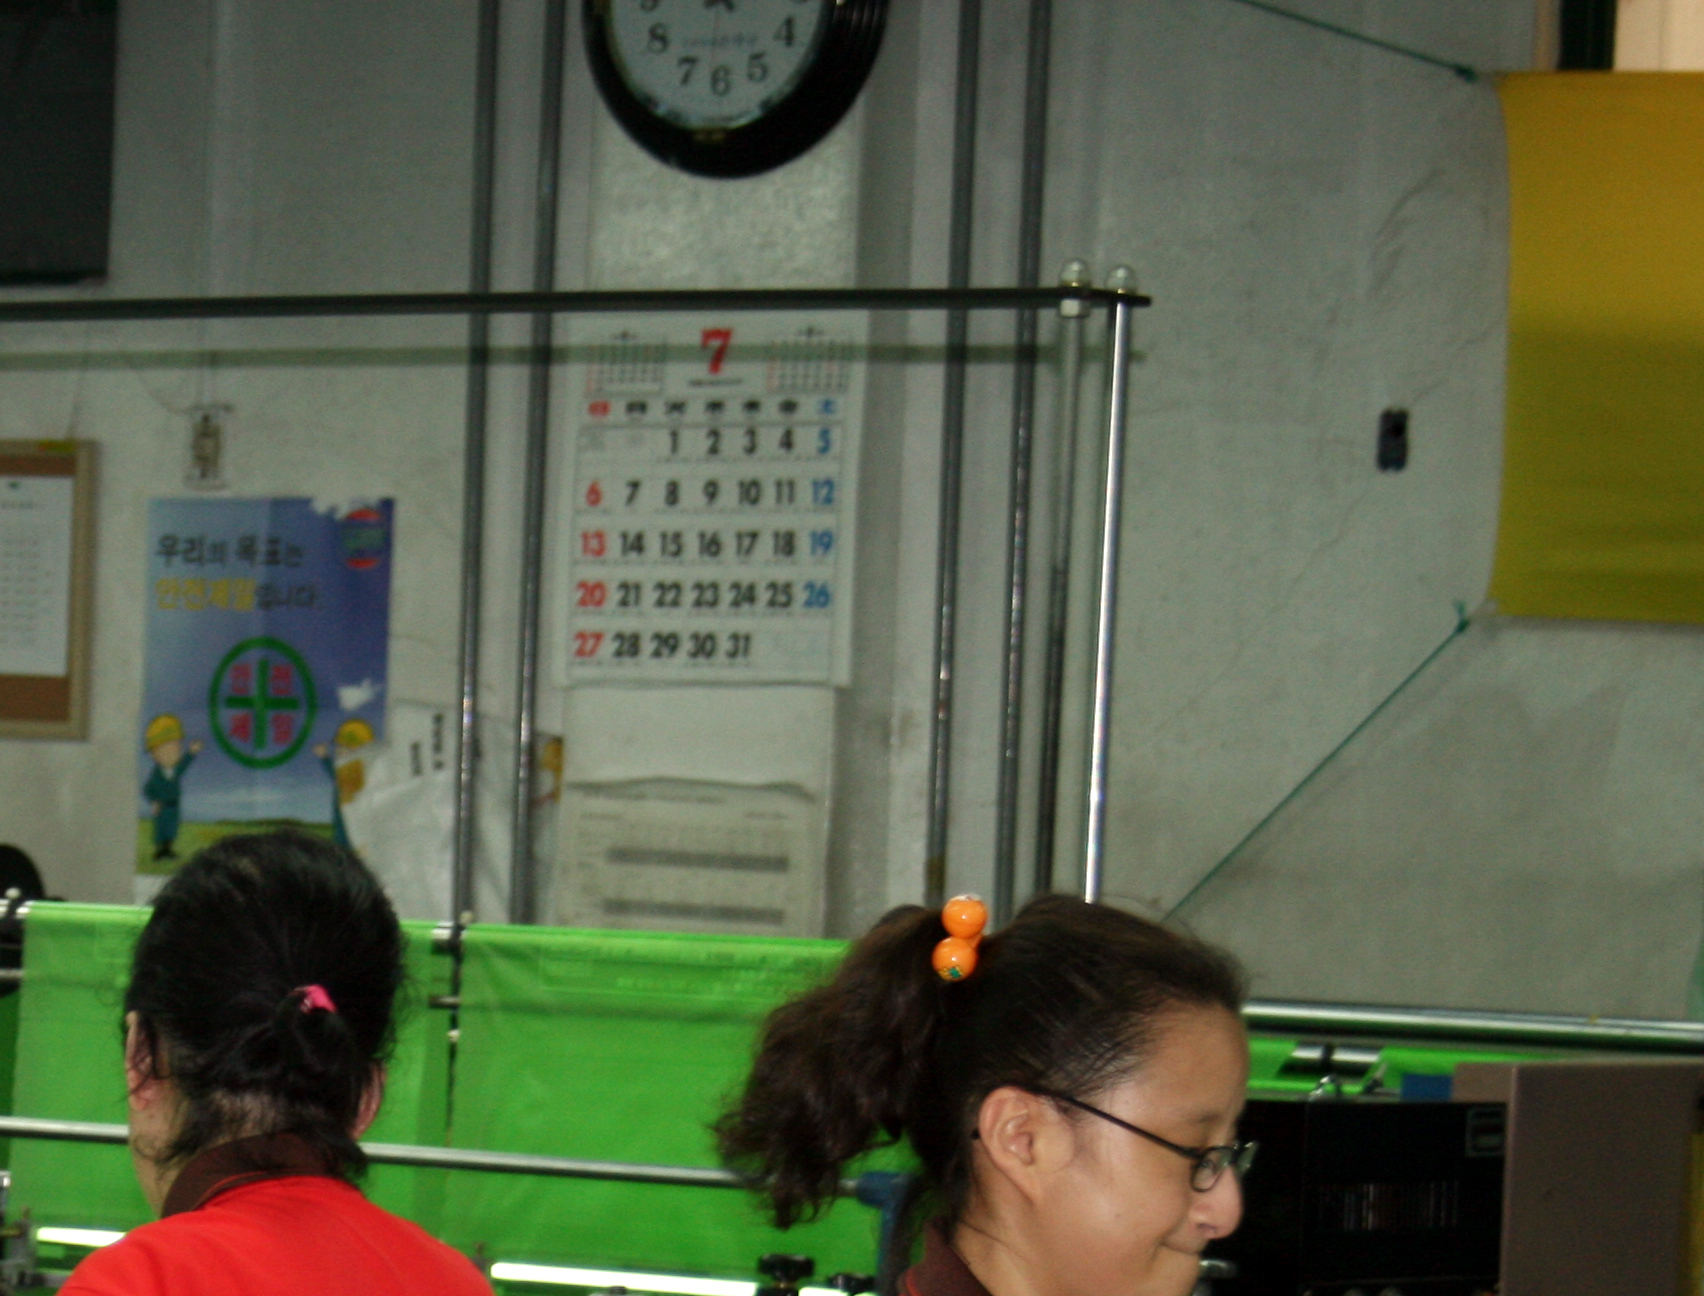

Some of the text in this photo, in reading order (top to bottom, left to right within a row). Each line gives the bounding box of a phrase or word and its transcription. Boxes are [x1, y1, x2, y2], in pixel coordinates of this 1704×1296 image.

[648, 22, 669, 53] 8
[774, 15, 794, 47] 4
[677, 57, 698, 86] 7
[710, 65, 732, 96] 6
[748, 53, 768, 82] 5
[701, 328, 733, 375] 7
[668, 424, 833, 457] 1 2 3 4 5
[585, 477, 837, 508] 6 7 8 9 10 11 12
[156, 534, 227, 567] 우리의
[236, 534, 304, 567] 목표는
[580, 528, 836, 560] 13 14 15 16 17 18 19
[576, 579, 833, 610] 20 21 22 23 24 25 26
[573, 629, 753, 661] 27 28 29 30 31
